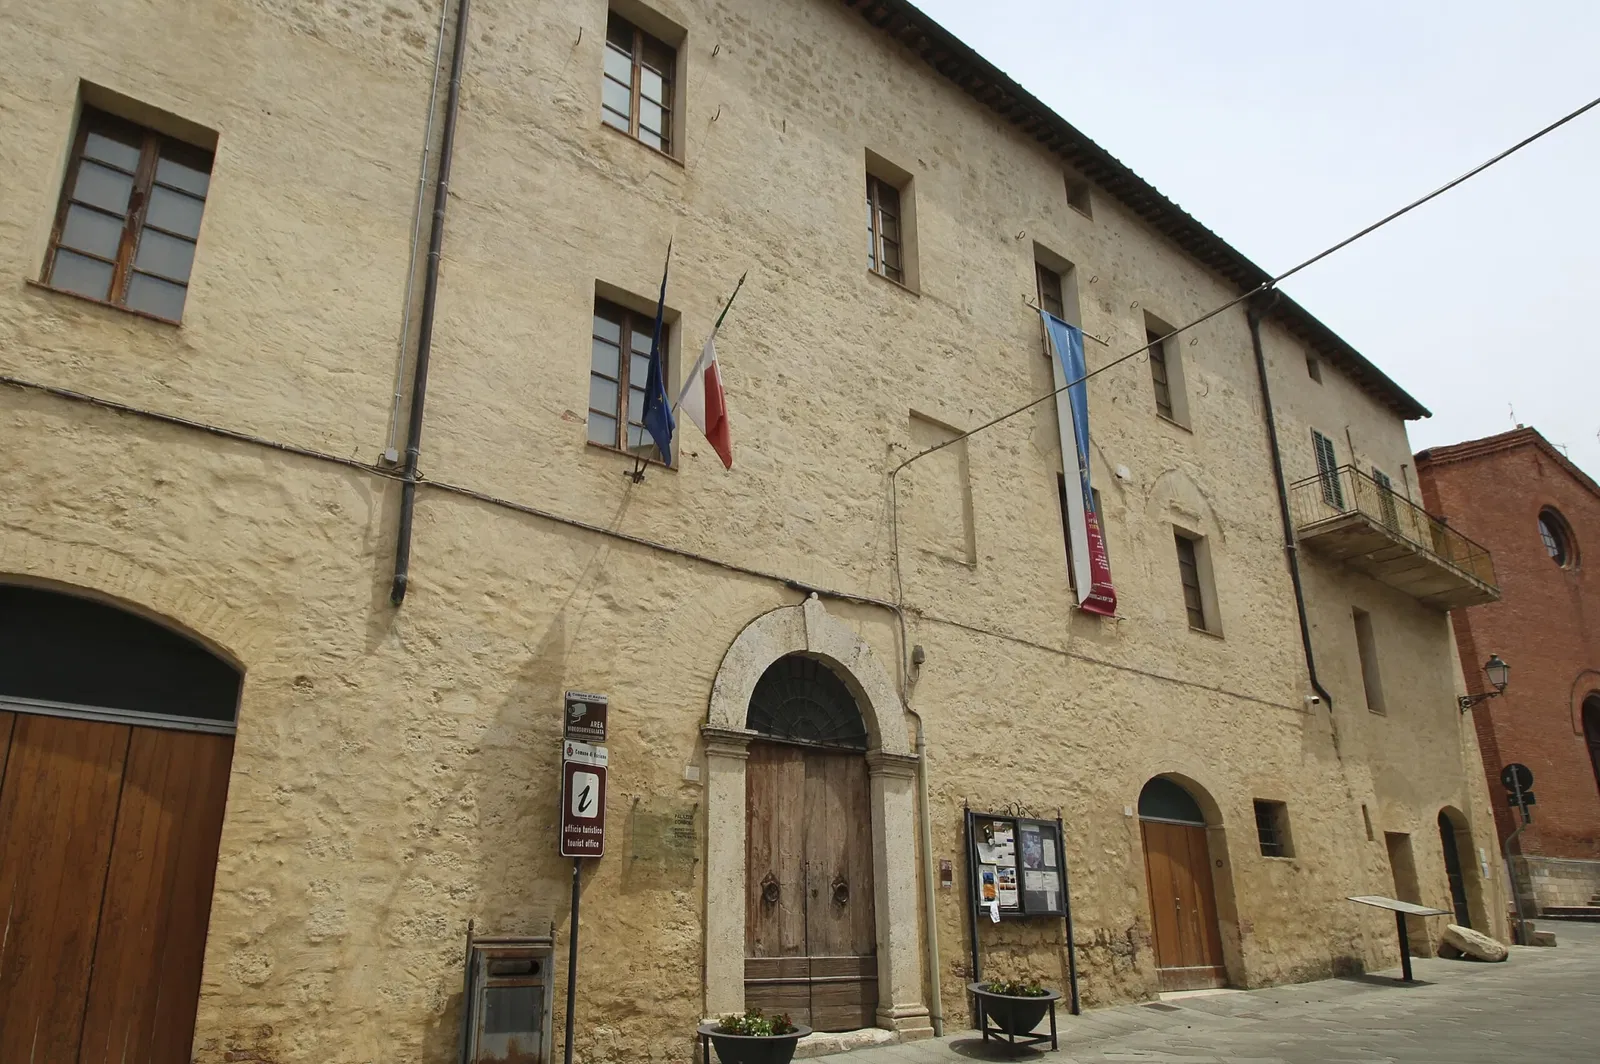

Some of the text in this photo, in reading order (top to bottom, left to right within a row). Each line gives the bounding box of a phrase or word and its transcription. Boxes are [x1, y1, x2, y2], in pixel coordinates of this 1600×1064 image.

[568, 726, 604, 734] VIDEOSORVEGLIATA
[565, 824, 602, 834] ufficio turistico
[567, 839, 599, 848] tourist office
